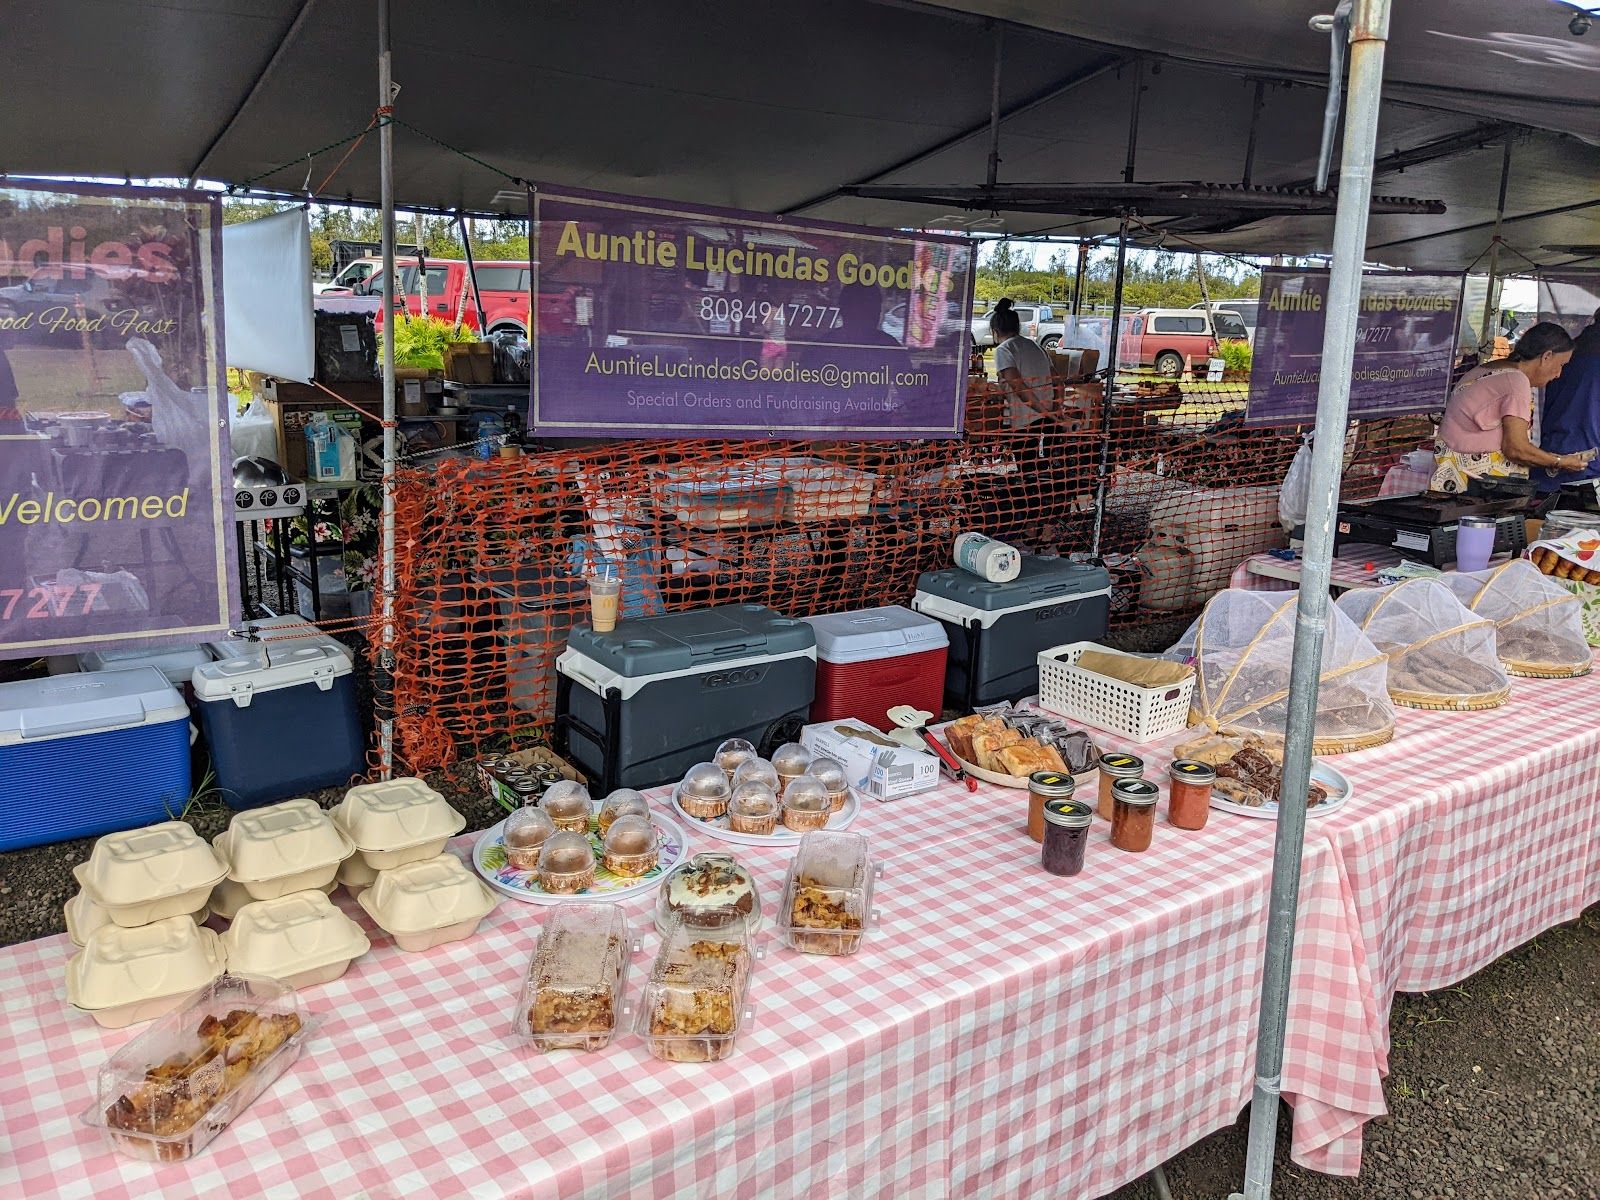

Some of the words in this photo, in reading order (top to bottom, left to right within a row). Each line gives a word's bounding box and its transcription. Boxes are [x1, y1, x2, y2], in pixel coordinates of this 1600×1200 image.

[555, 220, 677, 268] Auntie
[686, 235, 830, 282] Lucindas
[837, 253, 954, 293] Goodies
[700, 296, 841, 329] 8084947277
[1267, 287, 1322, 312] Auntie
[0, 312, 35, 330] od
[39, 306, 107, 333] Food
[111, 308, 178, 336] Fast
[584, 351, 929, 388] AuntieLucindasGoodies@gmail.com
[627, 389, 679, 409] Special
[683, 391, 732, 409] Orders
[736, 394, 762, 410] and
[766, 394, 841, 414] Fundraising
[844, 397, 899, 412] Available
[0, 583, 103, 620] 7277
[920, 764, 935, 775] 100
